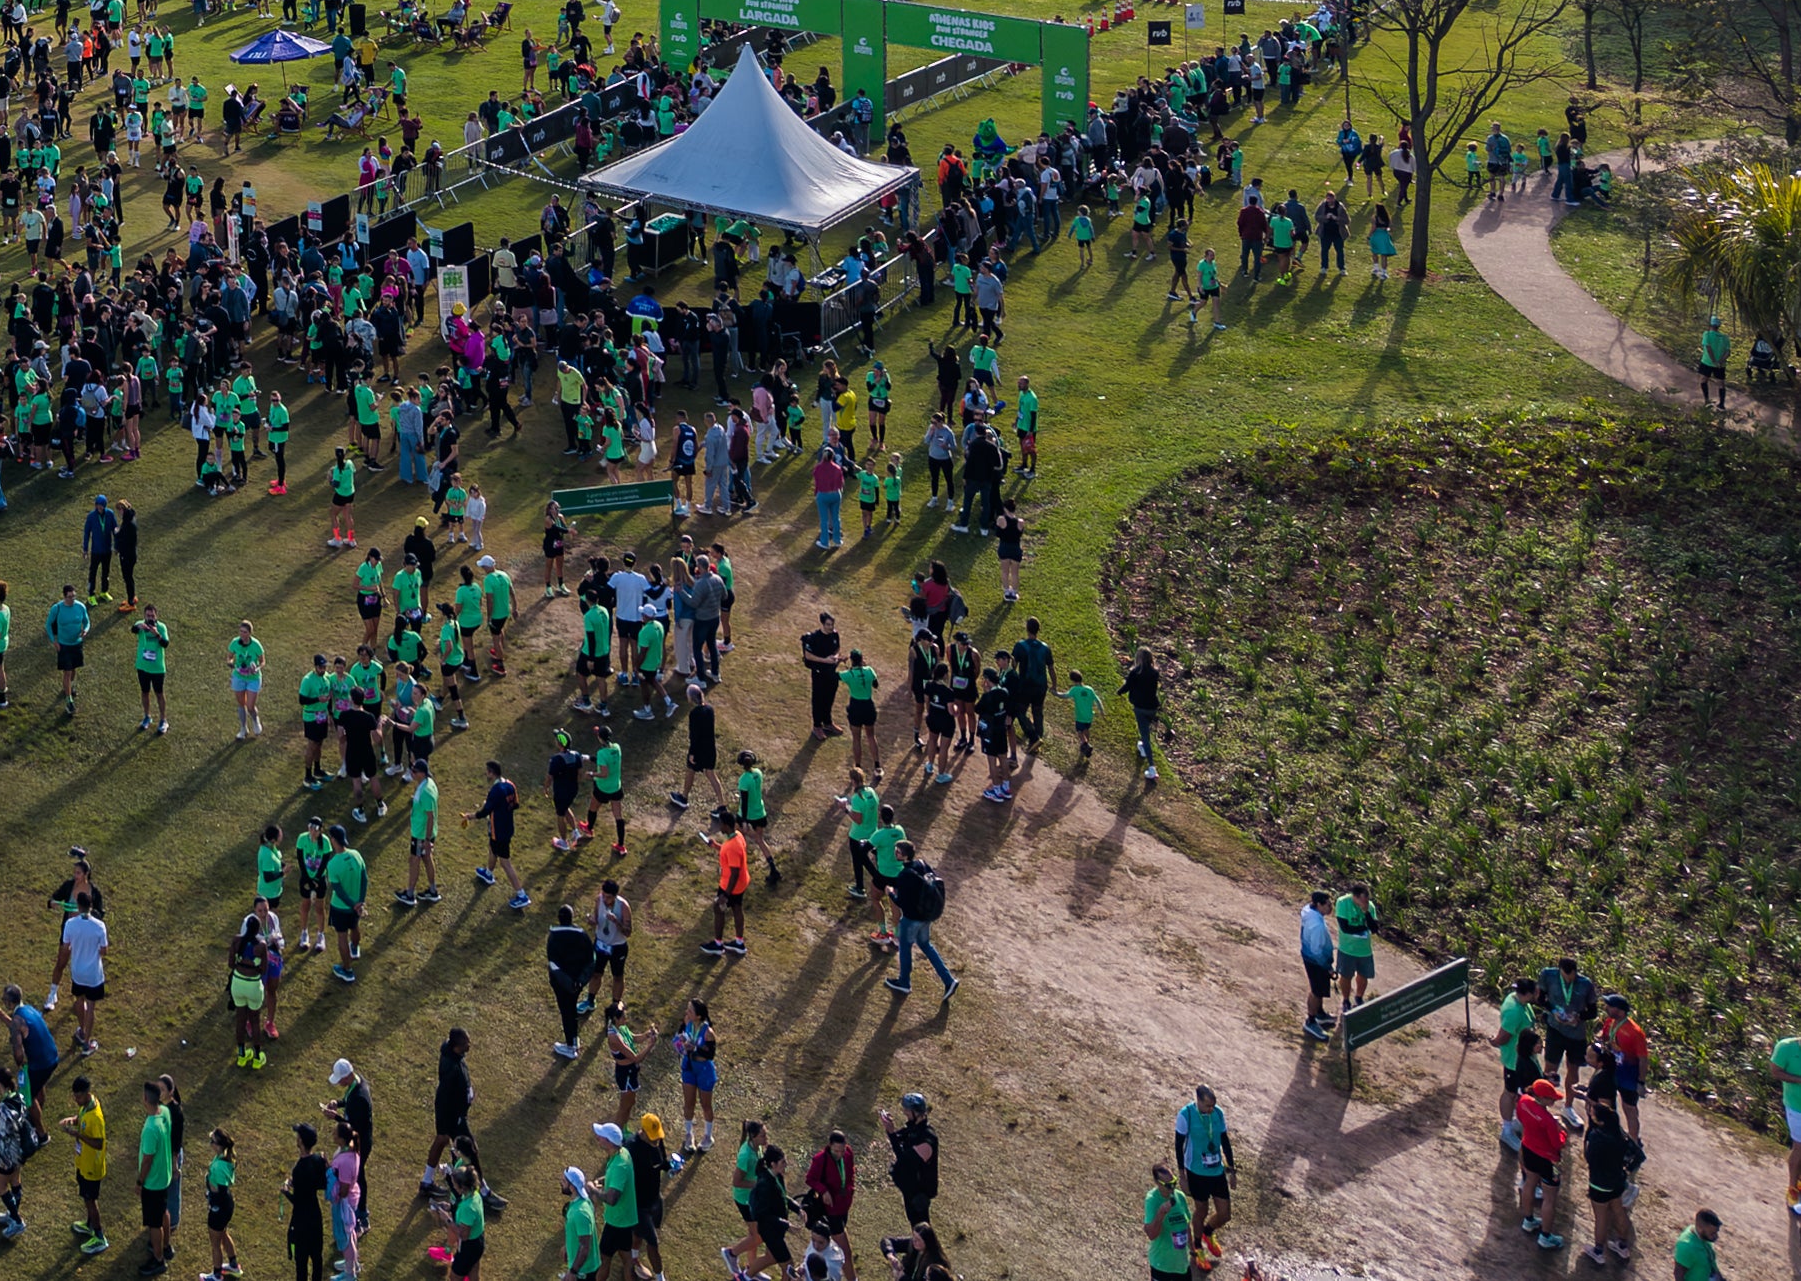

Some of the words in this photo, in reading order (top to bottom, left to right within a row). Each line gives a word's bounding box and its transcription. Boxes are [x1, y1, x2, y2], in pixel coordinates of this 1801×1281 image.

[739, 8, 800, 26] LARGADA
[929, 13, 971, 28] ATHENAS
[972, 18, 996, 31] KIDS
[671, 34, 688, 43] rvb
[1152, 28, 1168, 38] rvb
[930, 35, 994, 53] CHEGADA
[966, 59, 977, 71] rvb
[935, 72, 946, 84] rvb
[903, 85, 914, 97] rvb
[1055, 91, 1075, 101] rvb
